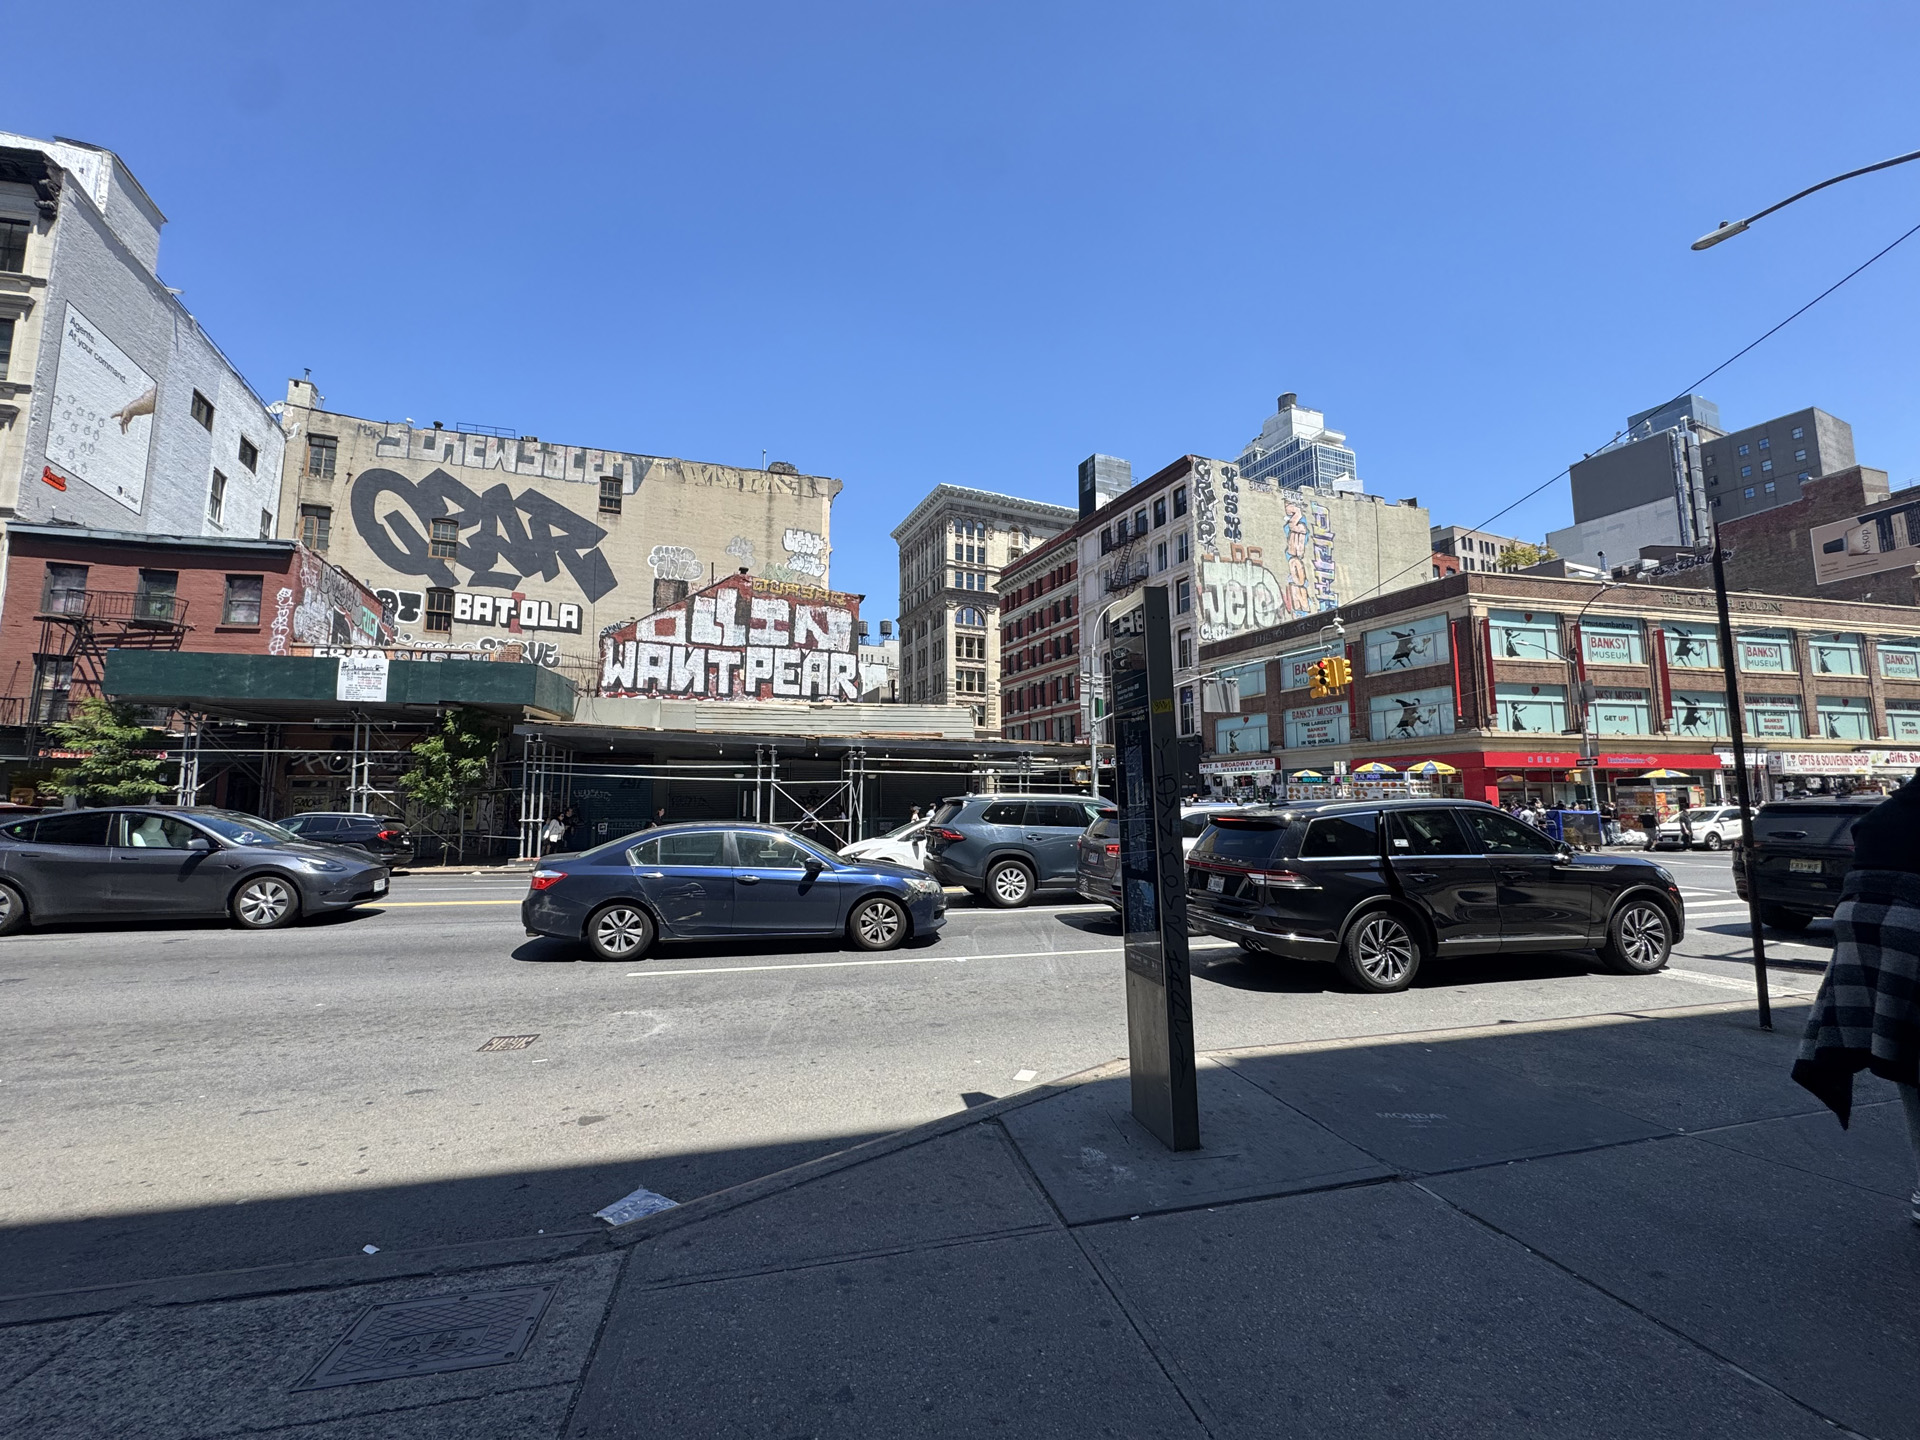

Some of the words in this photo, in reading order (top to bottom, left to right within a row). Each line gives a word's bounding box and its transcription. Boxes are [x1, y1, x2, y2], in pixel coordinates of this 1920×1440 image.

[69, 316, 96, 345] Agents.
[68, 329, 77, 341] At
[77, 339, 93, 355] your
[93, 352, 127, 384] command.
[1661, 594, 1681, 605] THE
[1739, 602, 1783, 612] BUILDING
[1582, 620, 1633, 630] #museumbanksy
[1590, 637, 1627, 650] BANKSY
[1591, 651, 1629, 660] MUSEUM
[1746, 646, 1778, 658] BANKSY
[1747, 660, 1780, 668] MUSEUM
[1885, 654, 1914, 665] BANKSY
[1614, 690, 1643, 700] MUSEUM
[1745, 696, 1768, 707] BANKSY
[1769, 696, 1795, 707] MUSEUM
[1292, 708, 1315, 720] BANKSY
[1316, 704, 1343, 716] MUSEUM
[1603, 714, 1617, 722] GET
[1618, 714, 1630, 722] UP!
[1797, 754, 1815, 766] GIFTS
[1816, 755, 1821, 766] &
[1821, 754, 1853, 767] SOUVENIRS
[1853, 755, 1869, 766] SHOP
[1889, 751, 1908, 764] Gifts
[1908, 752, 1920, 763] Sh
[1220, 761, 1252, 769] BROADWAY
[381, 1336, 477, 1358] TRAFFIC
